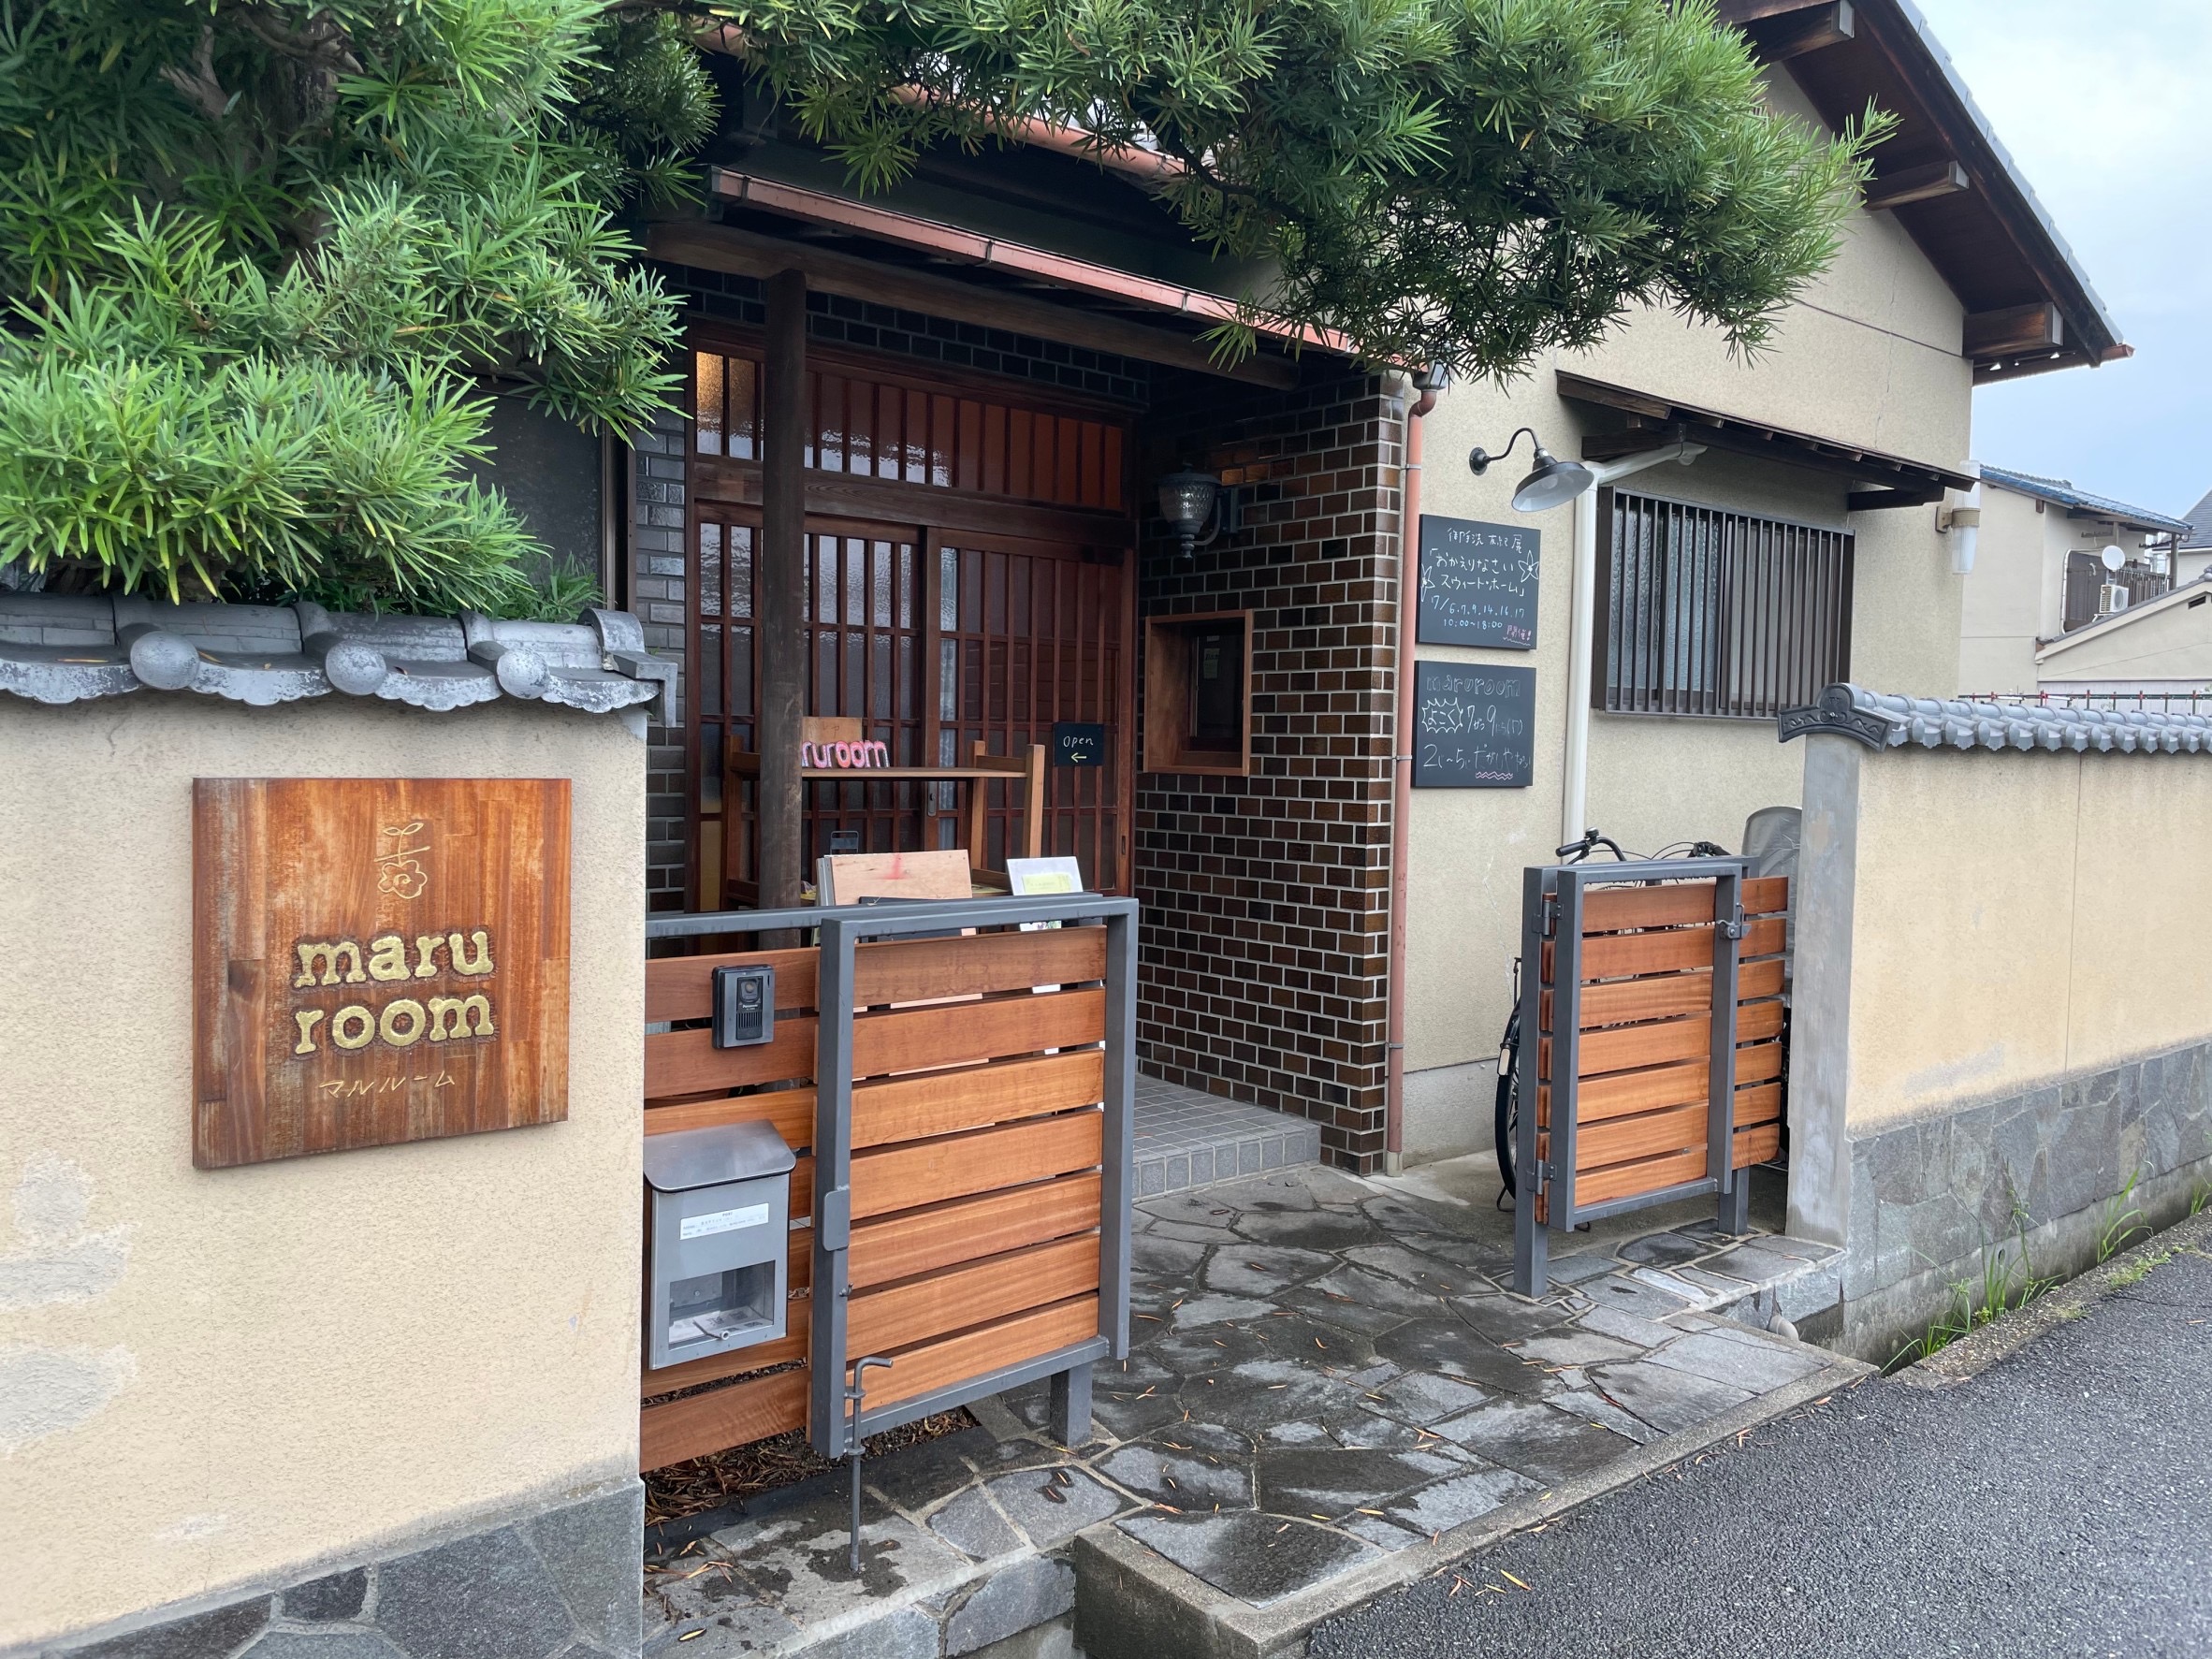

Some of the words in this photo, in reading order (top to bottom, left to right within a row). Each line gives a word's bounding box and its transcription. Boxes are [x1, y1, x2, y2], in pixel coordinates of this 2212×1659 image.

[802, 740, 890, 768] ruroom
[1063, 735, 1094, 749] Open
[294, 930, 494, 989] maru
[294, 994, 494, 1055] room
[319, 1070, 456, 1099] マルルーム
